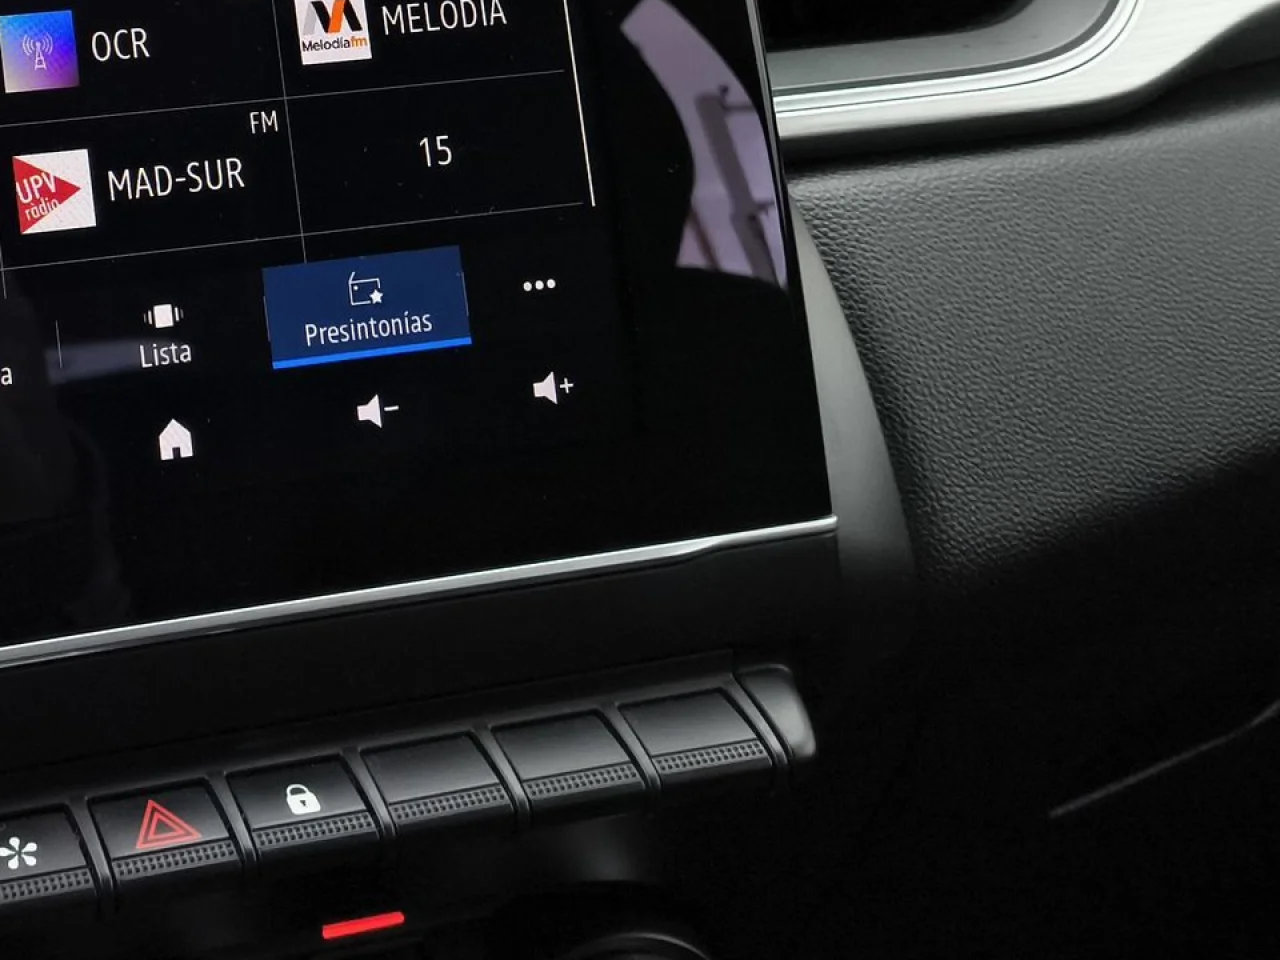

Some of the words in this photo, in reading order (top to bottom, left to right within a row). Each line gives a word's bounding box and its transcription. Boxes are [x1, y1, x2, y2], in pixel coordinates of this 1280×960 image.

[91, 27, 150, 62] OCR
[249, 110, 279, 134] FM
[419, 135, 452, 167] 15
[16, 172, 56, 204] UPV
[107, 157, 245, 201] MAD-SUR
[304, 311, 433, 347] Presintonías
[139, 342, 192, 368] Lista
